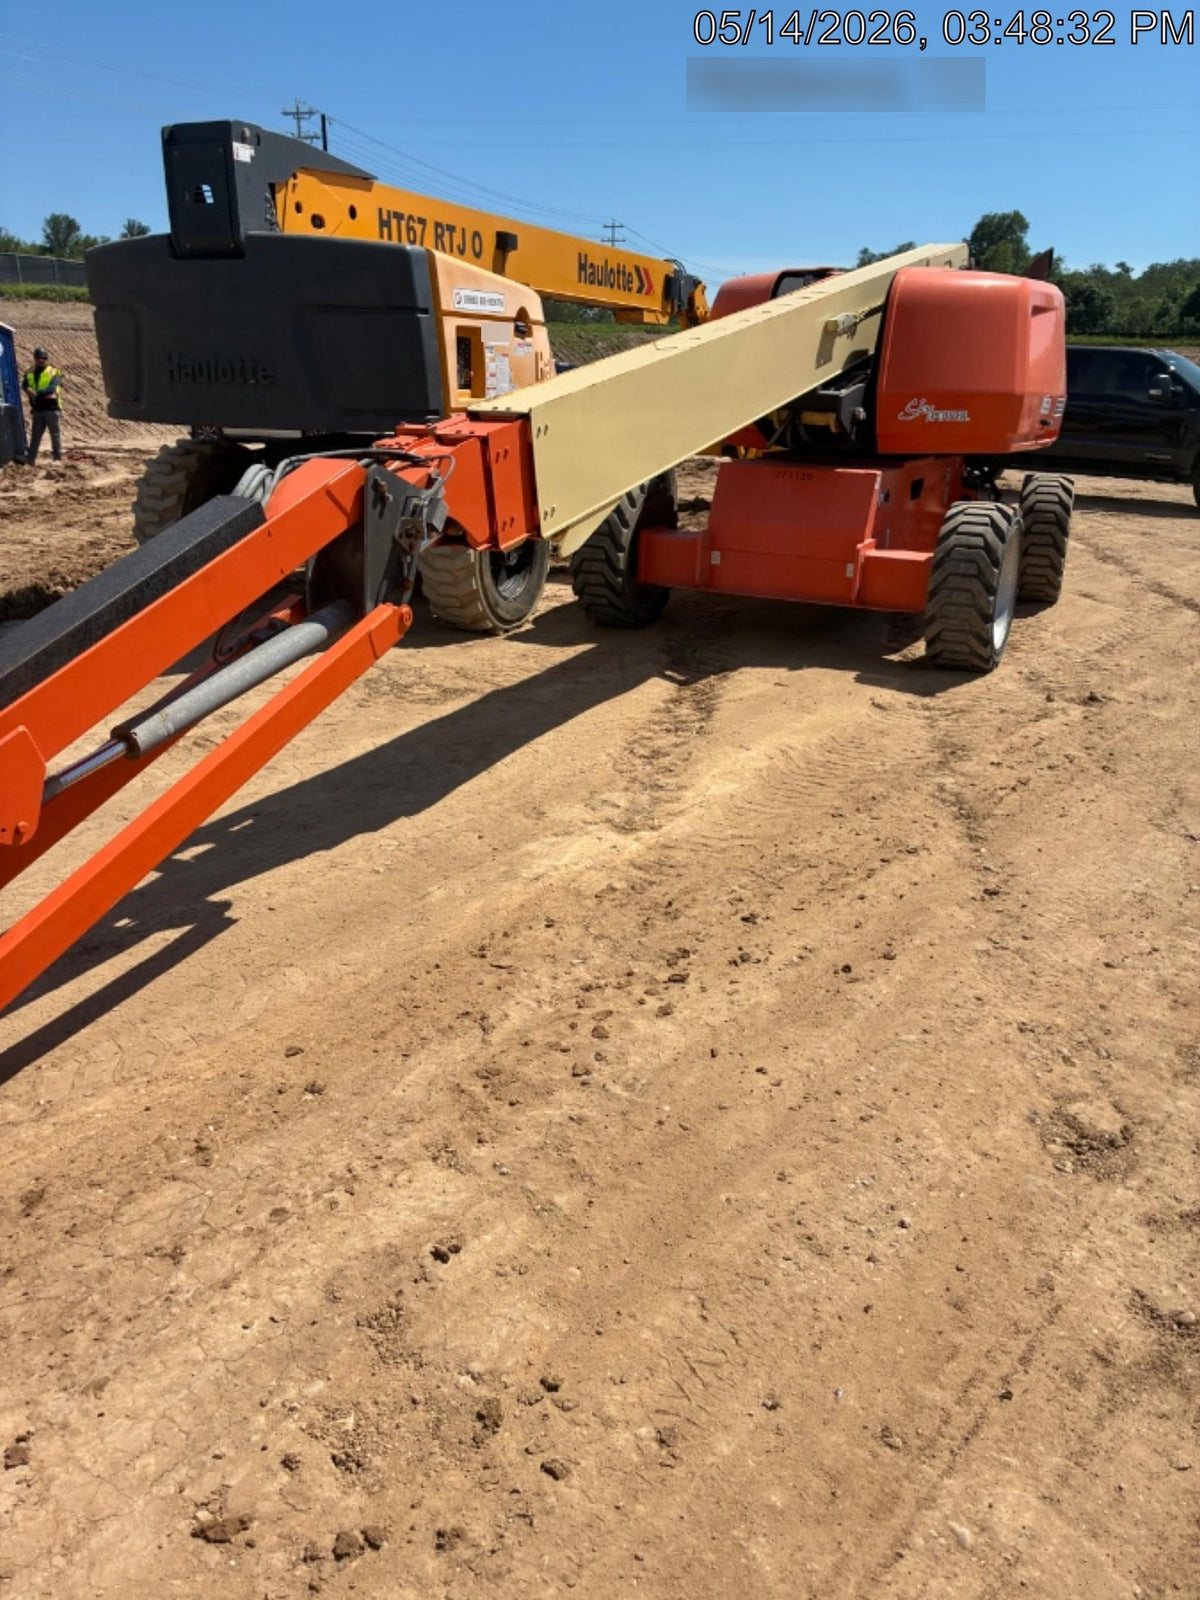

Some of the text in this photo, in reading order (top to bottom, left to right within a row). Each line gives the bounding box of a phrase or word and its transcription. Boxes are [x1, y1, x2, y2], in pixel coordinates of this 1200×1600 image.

[378, 208, 427, 246] HT67
[434, 220, 466, 256] RTJ
[577, 252, 634, 293] Haulotte
